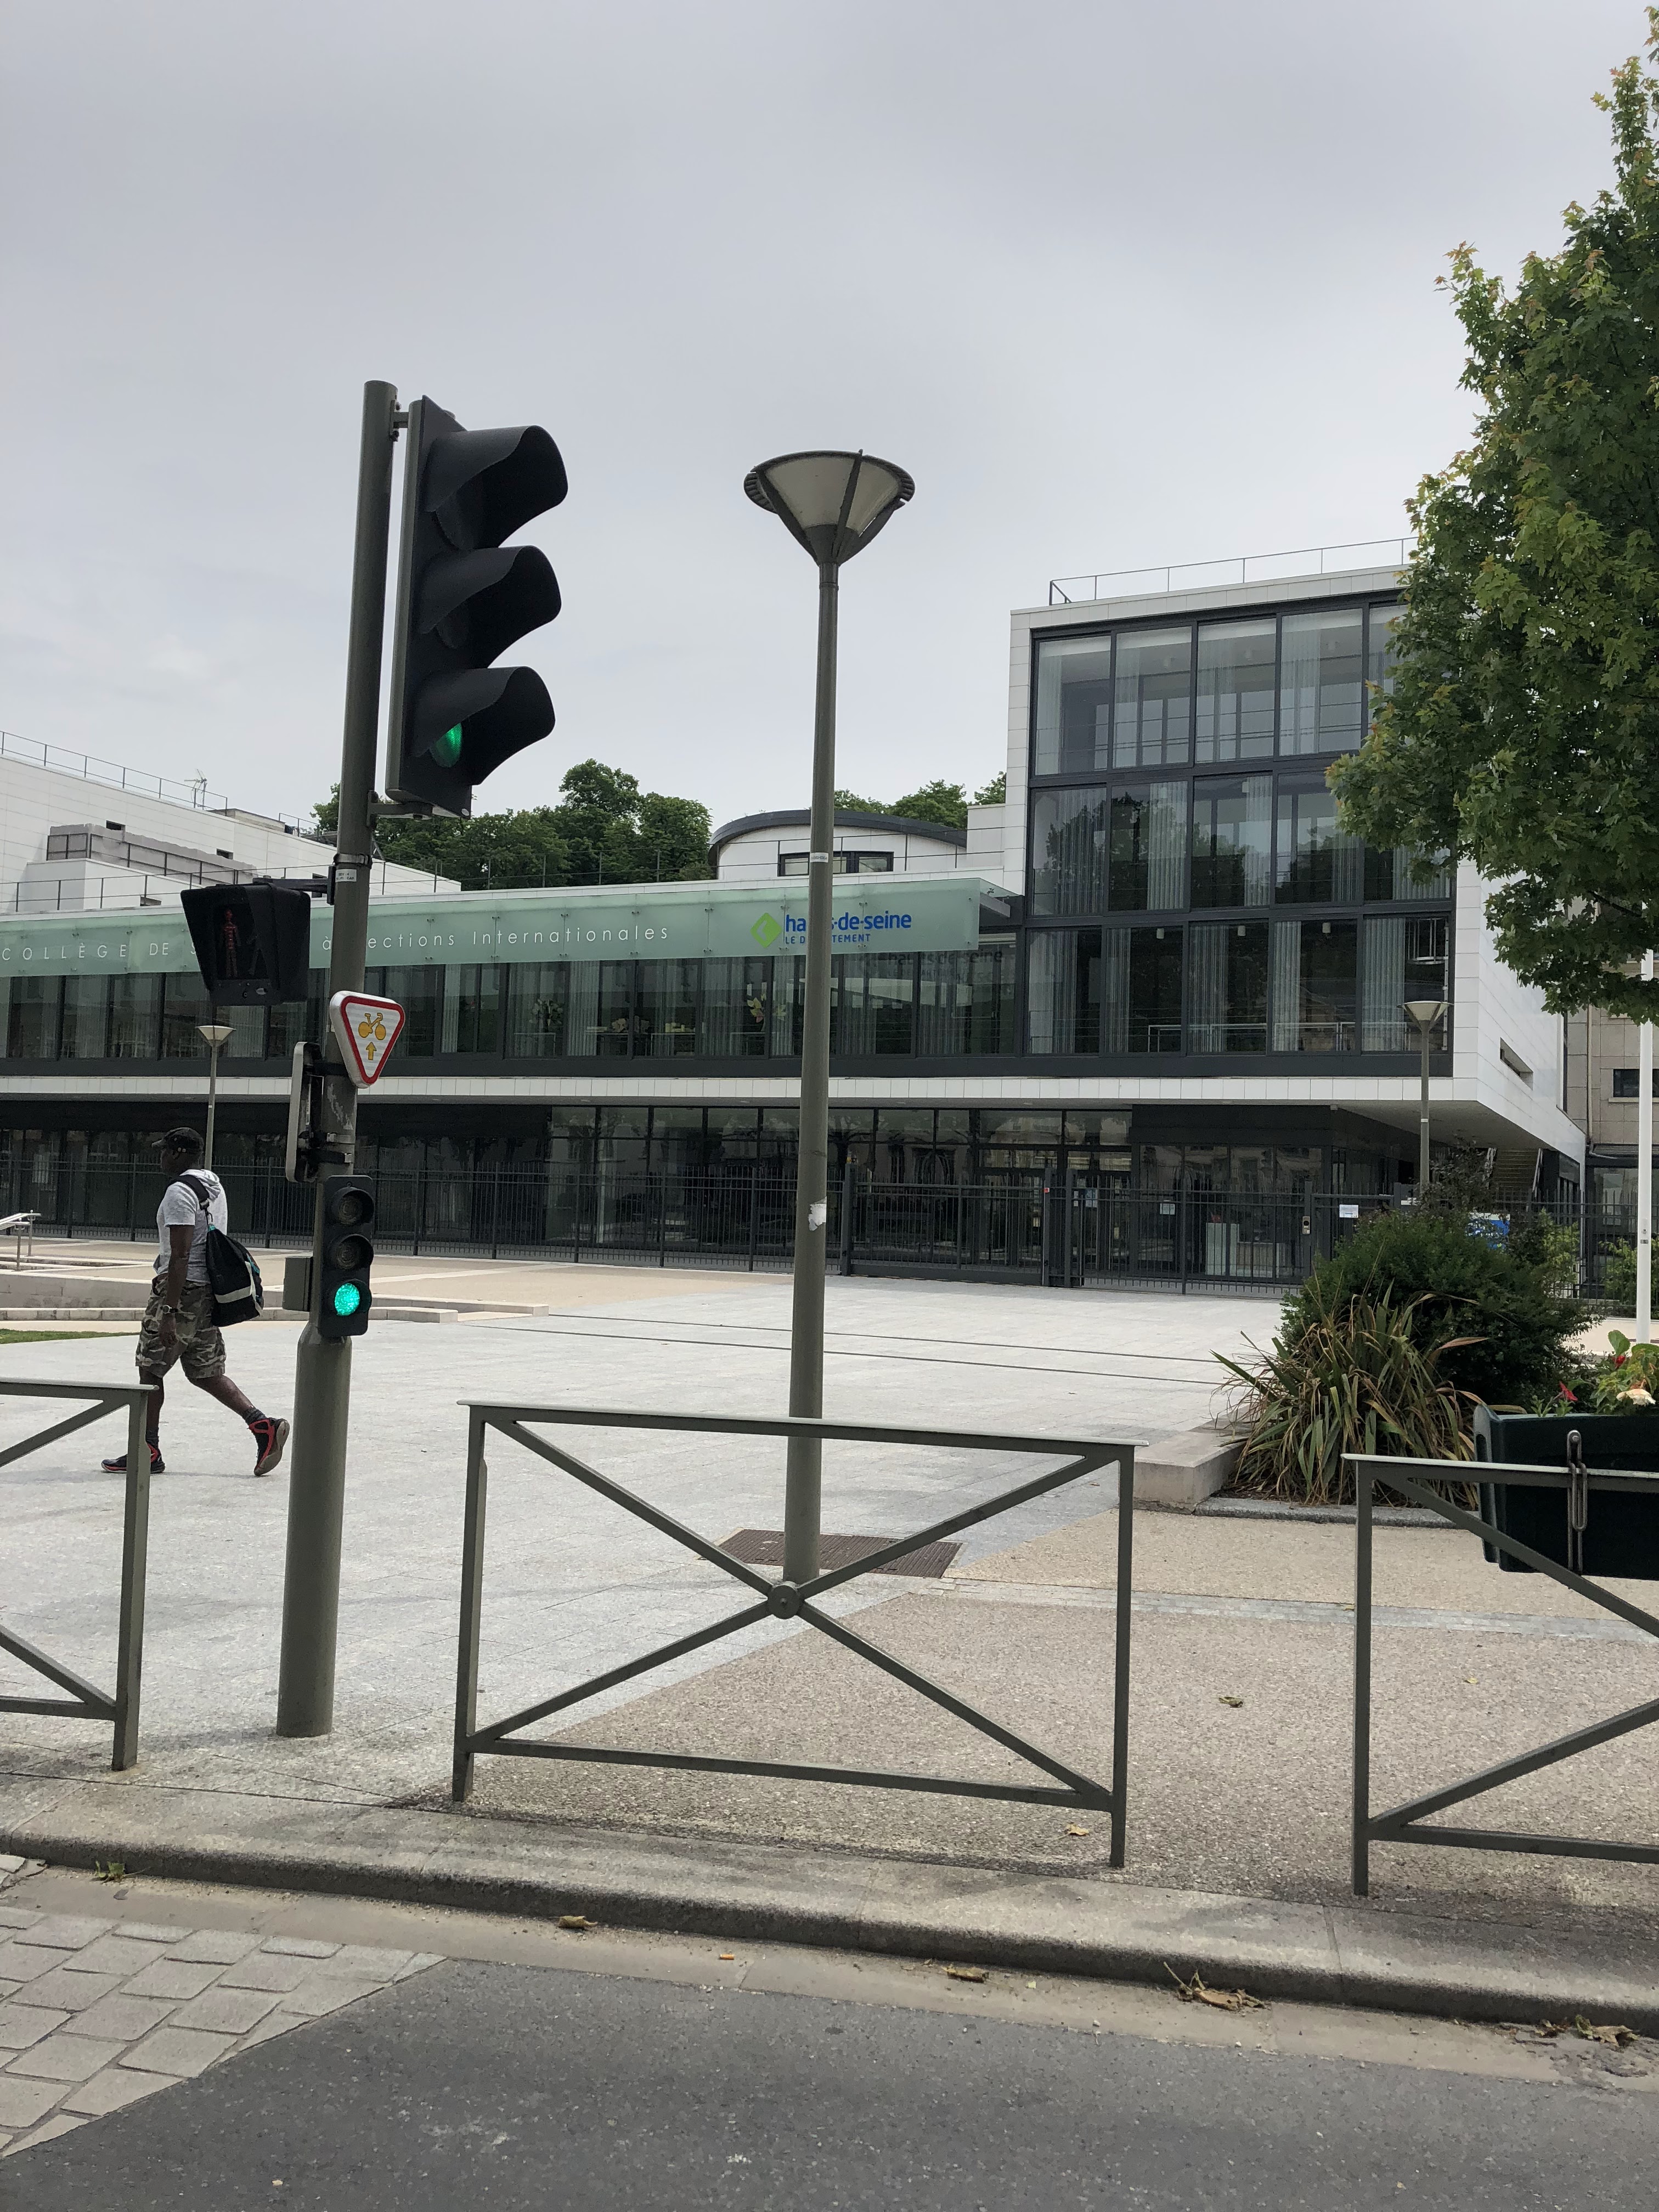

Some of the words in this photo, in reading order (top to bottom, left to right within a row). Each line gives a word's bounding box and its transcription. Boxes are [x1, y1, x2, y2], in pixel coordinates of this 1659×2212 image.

[786, 910, 912, 932] ha-de-seine
[2, 943, 126, 961] COLLÈGE
[149, 943, 169, 956] DE
[322, 936, 331, 950] à
[368, 934, 454, 949] ections
[473, 925, 667, 944] Internationales
[785, 936, 795, 944] LE
[800, 934, 871, 944] DTEMENT
